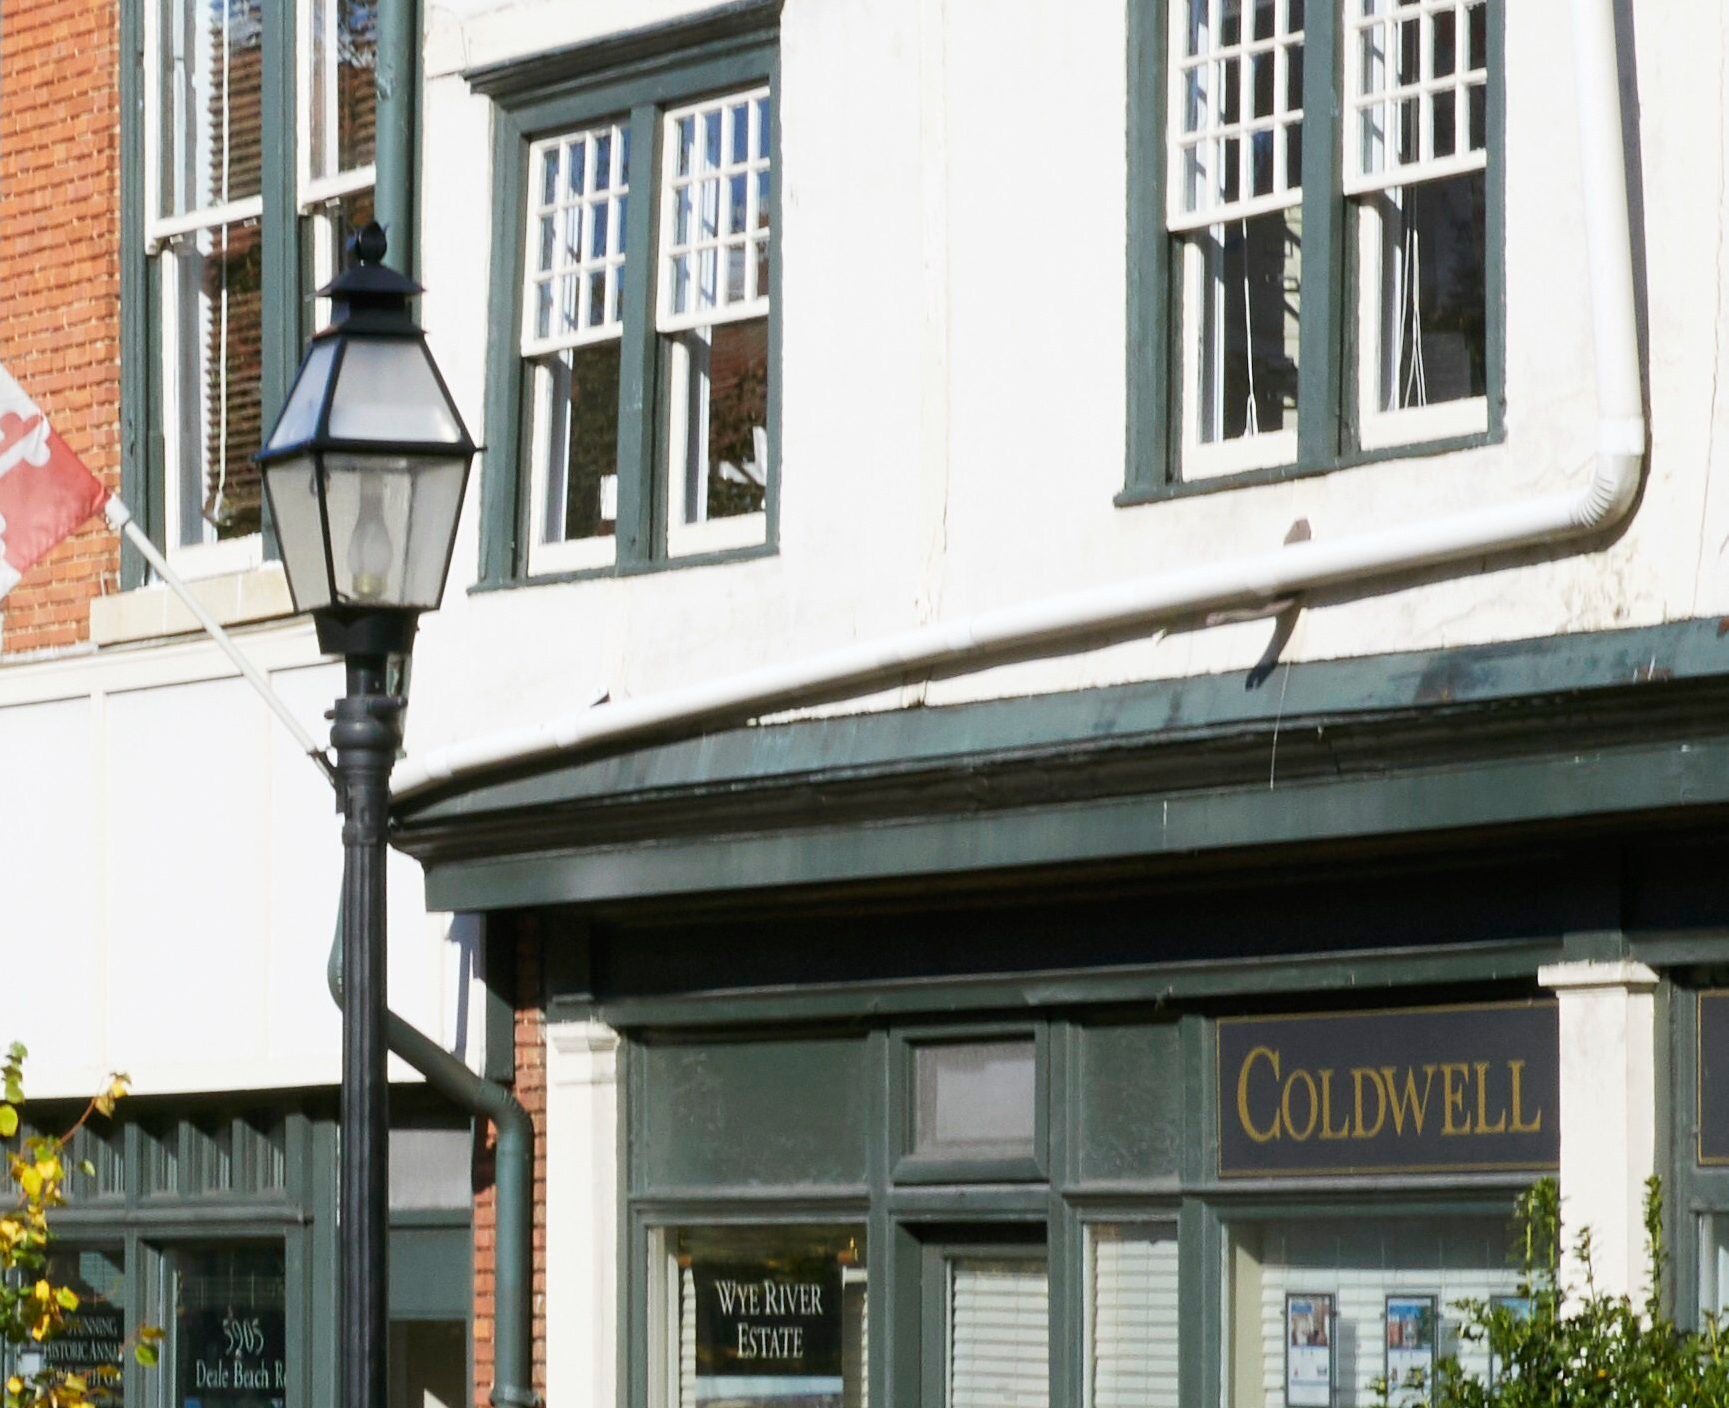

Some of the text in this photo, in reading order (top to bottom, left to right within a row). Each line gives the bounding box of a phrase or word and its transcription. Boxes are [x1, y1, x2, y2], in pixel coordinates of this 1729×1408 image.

[1236, 1044, 1542, 1143] COLDWELL
[714, 1278, 824, 1316] WYE RIVER
[737, 1322, 804, 1359] ESTATE
[195, 1358, 229, 1388] Deale
[233, 1358, 270, 1389] Beach
